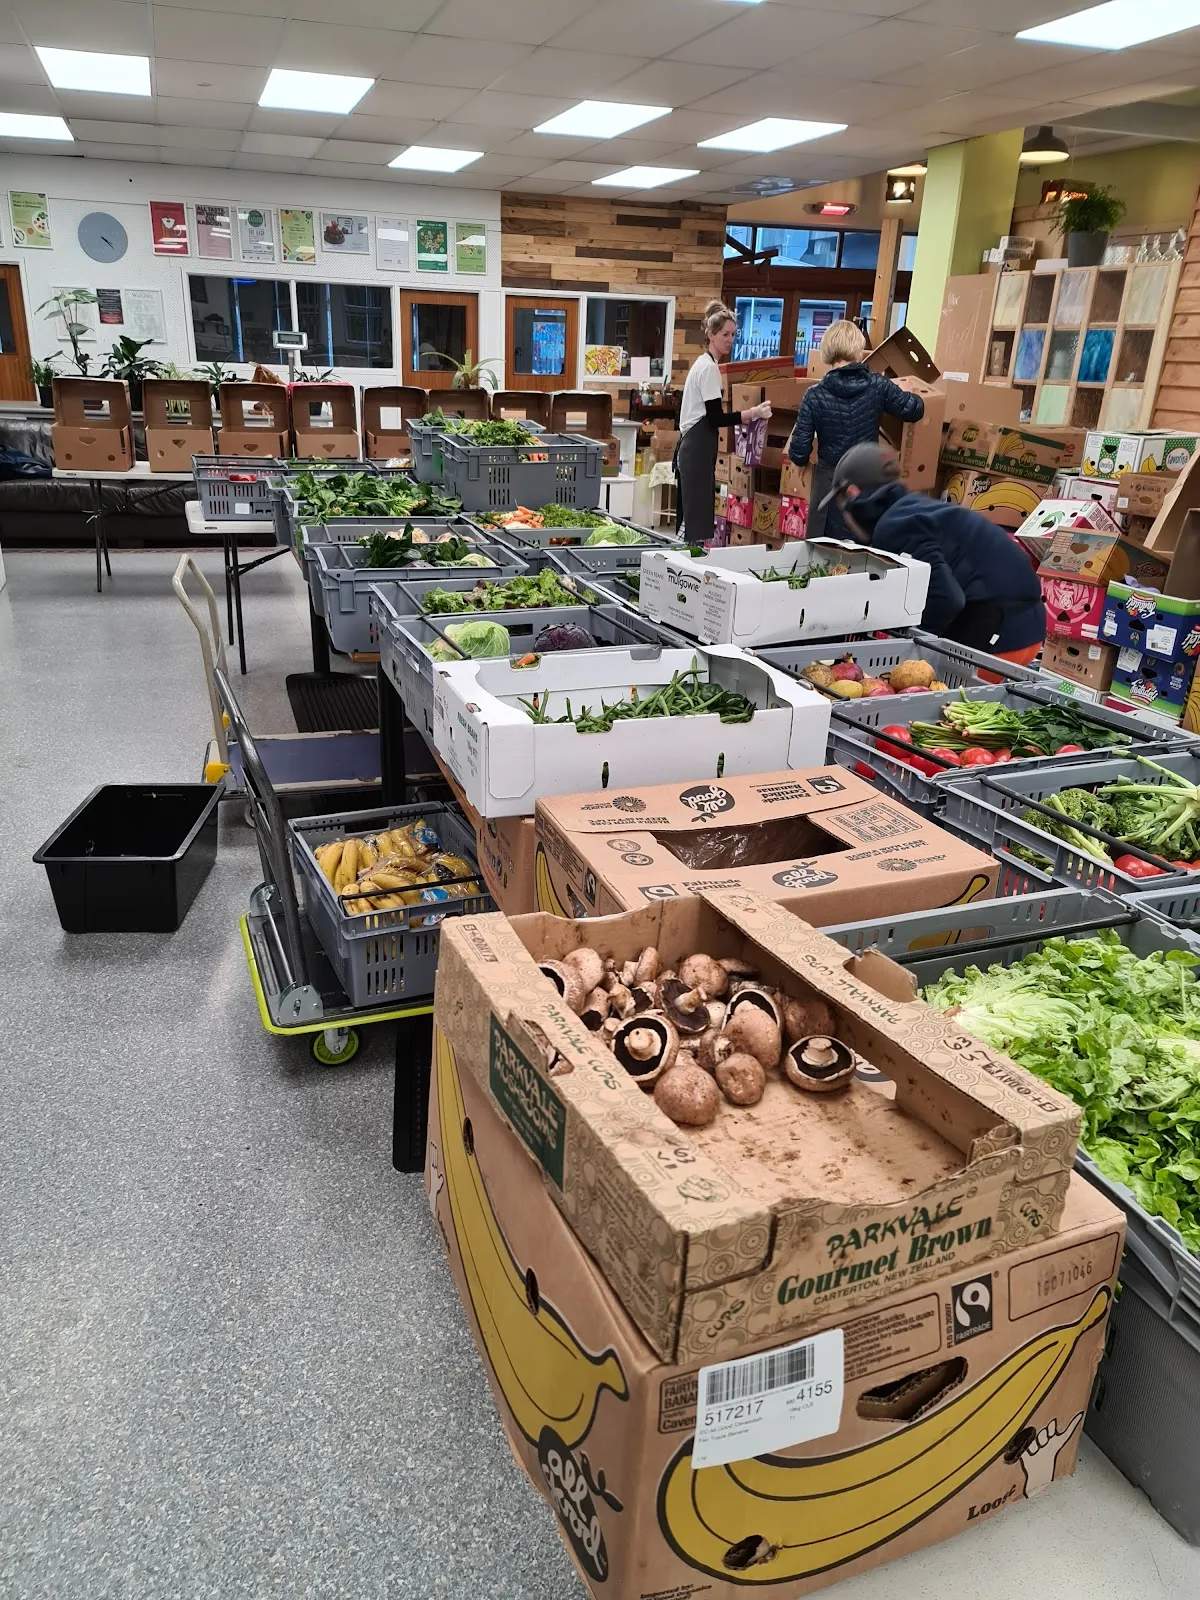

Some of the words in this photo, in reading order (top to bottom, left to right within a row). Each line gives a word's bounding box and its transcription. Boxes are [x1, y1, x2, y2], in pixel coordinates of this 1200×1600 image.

[683, 785, 727, 807] good
[697, 798, 727, 813] all
[681, 879, 742, 887] Fairtrade
[783, 869, 810, 881] all
[784, 871, 835, 888] good
[687, 884, 741, 893] Certified
[543, 1004, 592, 1055] PARKVALE
[588, 1059, 621, 1090] CUPS
[494, 1029, 558, 1127] PARKVALE
[826, 1194, 964, 1258] PARKVALE
[778, 1247, 899, 1305] Gourmet
[907, 1216, 992, 1264] Brown
[884, 1270, 906, 1284] NEW
[910, 1252, 957, 1278] ZEALAND
[956, 1321, 992, 1342] FAIRTRADE
[704, 1400, 763, 1426] 517217
[796, 1380, 833, 1402] 4155
